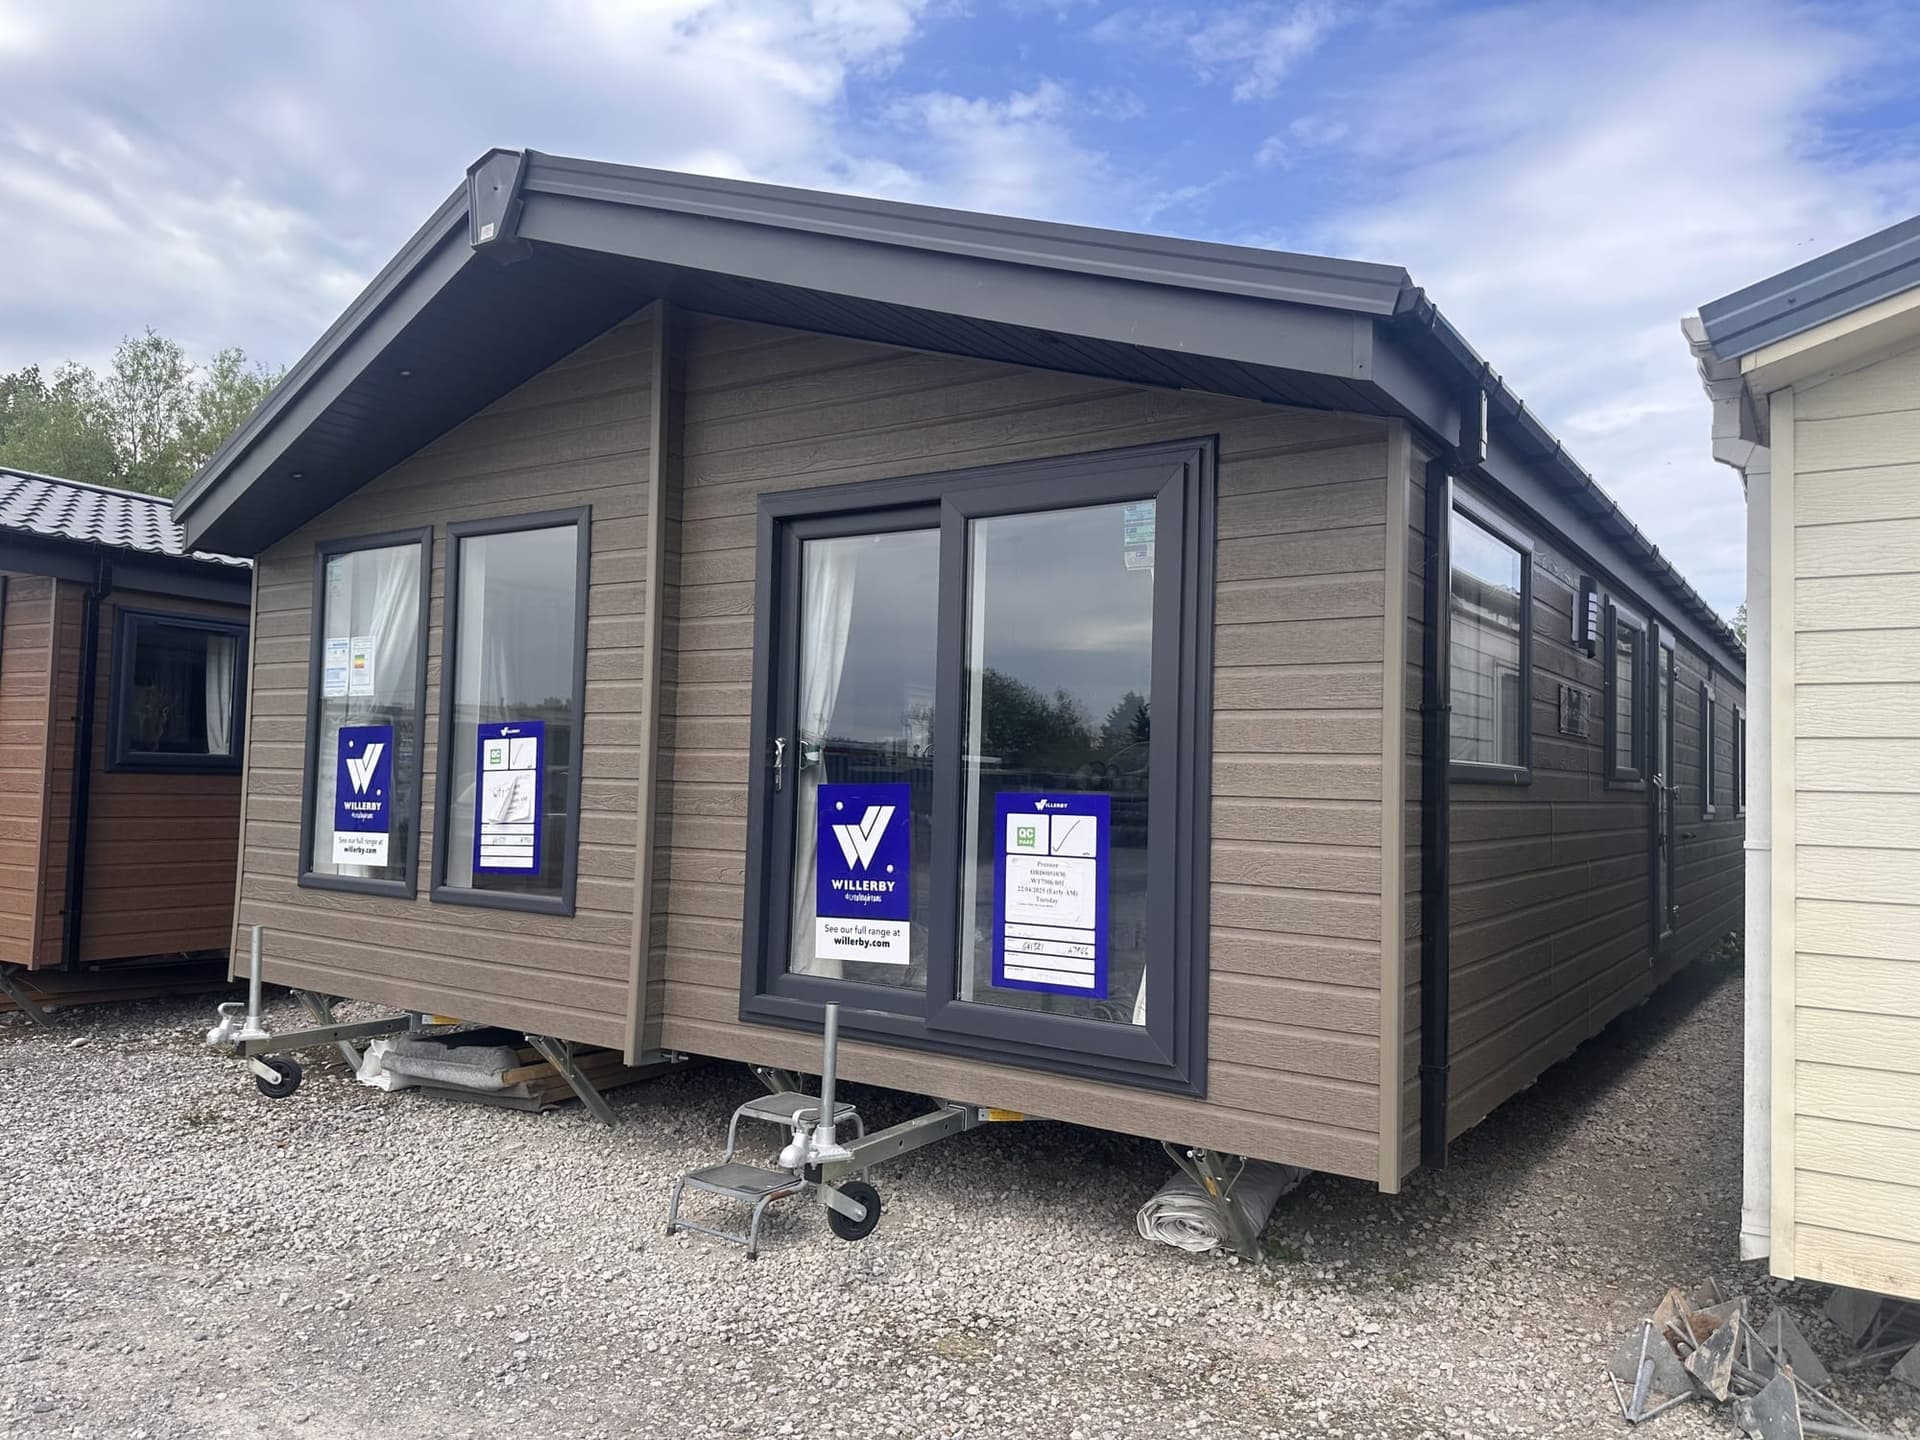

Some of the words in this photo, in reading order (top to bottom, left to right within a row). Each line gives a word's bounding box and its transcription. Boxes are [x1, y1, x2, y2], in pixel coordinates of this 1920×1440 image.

[343, 801, 382, 811] WILLERBY
[1034, 799, 1068, 811] WILLERBY
[832, 805, 896, 871] W
[1018, 828, 1034, 838] QC
[344, 846, 377, 855] willerby.com
[831, 879, 895, 892] WILLERBY
[824, 923, 839, 933] See
[840, 926, 853, 934] our
[855, 925, 867, 935] full
[868, 927, 891, 938] range
[892, 929, 901, 937] at
[834, 936, 890, 949] willerby.com
